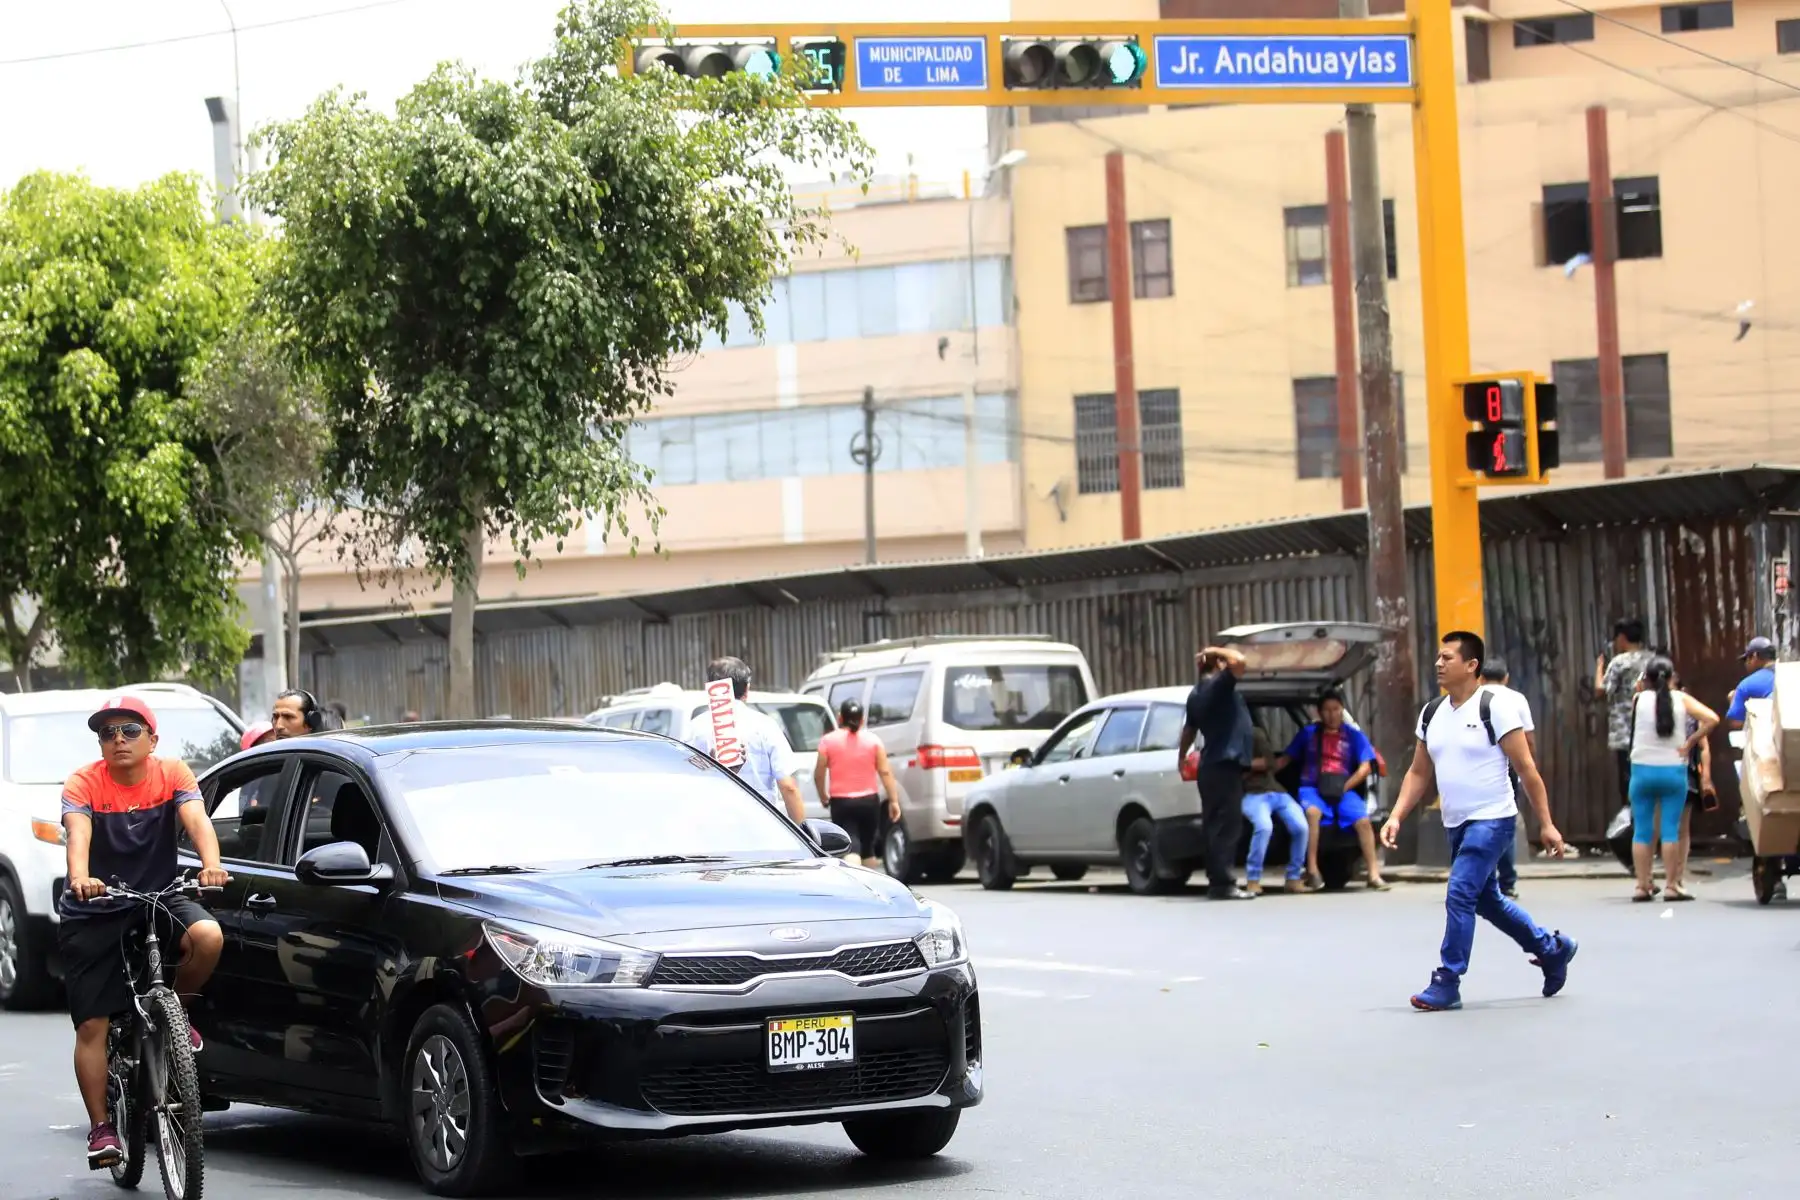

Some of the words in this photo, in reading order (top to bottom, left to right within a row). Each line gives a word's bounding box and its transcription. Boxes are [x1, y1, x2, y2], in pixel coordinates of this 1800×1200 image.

[869, 46, 973, 63] MUNICIPALIDAD
[1170, 45, 1204, 75] Jr.
[1214, 45, 1397, 80] Andahuaylas
[884, 67, 903, 83] DE
[926, 66, 960, 83] LIMA
[708, 682, 741, 765] CALLAO
[796, 1018, 826, 1030] PERU
[771, 1027, 850, 1060] BMP-304
